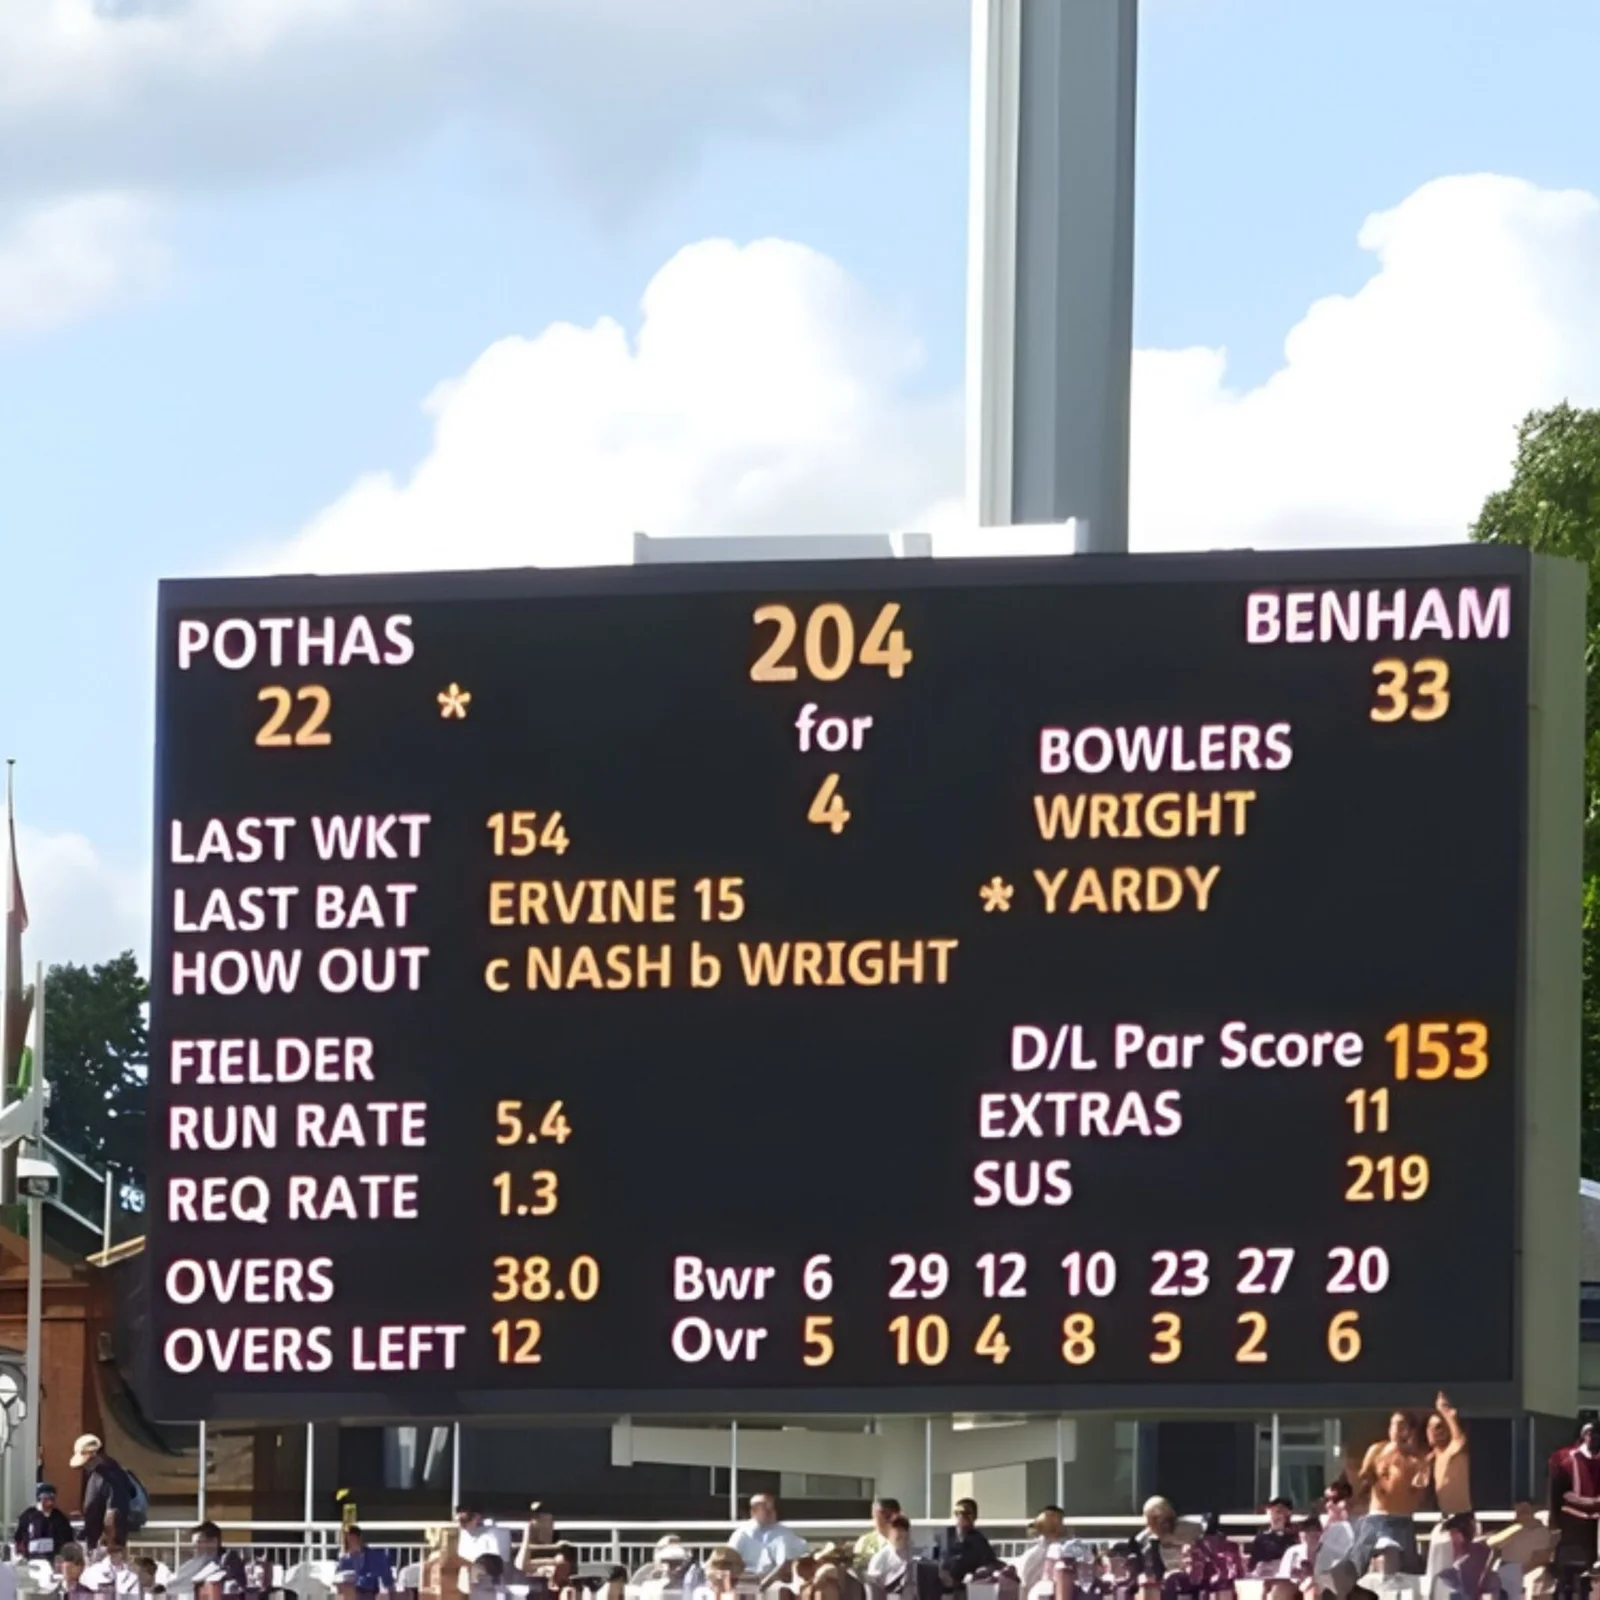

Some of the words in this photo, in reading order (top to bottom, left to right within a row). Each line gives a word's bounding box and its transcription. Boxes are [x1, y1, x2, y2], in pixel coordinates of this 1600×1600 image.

[1246, 586, 1511, 644] BENHAM
[179, 614, 414, 669] POTHAS
[750, 603, 912, 681] 204
[1370, 658, 1450, 722] 33
[256, 685, 332, 747] 22
[795, 703, 873, 753] for
[1039, 723, 1292, 774] BOWLERS
[807, 773, 850, 834] 4
[1034, 790, 1256, 840] WRIGHT
[171, 817, 296, 863] LAST
[311, 814, 431, 860] WKT
[487, 811, 569, 856] 154
[174, 886, 300, 932] LAST
[316, 883, 418, 929] BAT
[490, 879, 677, 926] ERVINE
[694, 877, 745, 921] 15
[1034, 866, 1220, 914] YARDY
[172, 949, 302, 995] HOW
[318, 946, 429, 993] OUT
[485, 959, 509, 992] c
[527, 943, 672, 991] NASH
[691, 941, 721, 988] b
[738, 940, 958, 986] WRIGHT
[171, 1037, 375, 1085] FIELDER
[1010, 1024, 1097, 1072] D/L
[1115, 1024, 1205, 1070] Par
[1220, 1021, 1363, 1069] Score
[1385, 1021, 1489, 1080] 153
[170, 1105, 277, 1151] RUN
[296, 1102, 426, 1148] RATE
[496, 1101, 572, 1145] 5.4
[979, 1090, 1182, 1138] EXTRAS
[1345, 1088, 1388, 1134] 11
[169, 1176, 270, 1224] REQ
[289, 1174, 418, 1220] RATE
[493, 1170, 558, 1216] 1.3
[973, 1160, 1072, 1207] SUS
[1345, 1155, 1429, 1202] 219
[166, 1257, 333, 1305] OVERS
[492, 1255, 599, 1302] 38.0
[674, 1256, 775, 1302] Bwr
[803, 1254, 833, 1300] 6
[889, 1253, 949, 1300] 29
[976, 1252, 1027, 1298] 12
[1062, 1251, 1116, 1297] 10
[1150, 1250, 1209, 1296] 23
[1237, 1248, 1296, 1294] 27
[1326, 1246, 1390, 1293] 20
[164, 1326, 333, 1373] OVERS
[353, 1324, 466, 1370] LEFT
[492, 1319, 541, 1364] 12
[671, 1316, 767, 1363] Ovr
[803, 1316, 834, 1367] 5
[889, 1314, 949, 1366] 10
[975, 1314, 1010, 1365] 4
[1062, 1312, 1096, 1365] 8
[1150, 1312, 1182, 1364] 3
[1236, 1311, 1268, 1363] 2
[1327, 1310, 1362, 1363] 6
